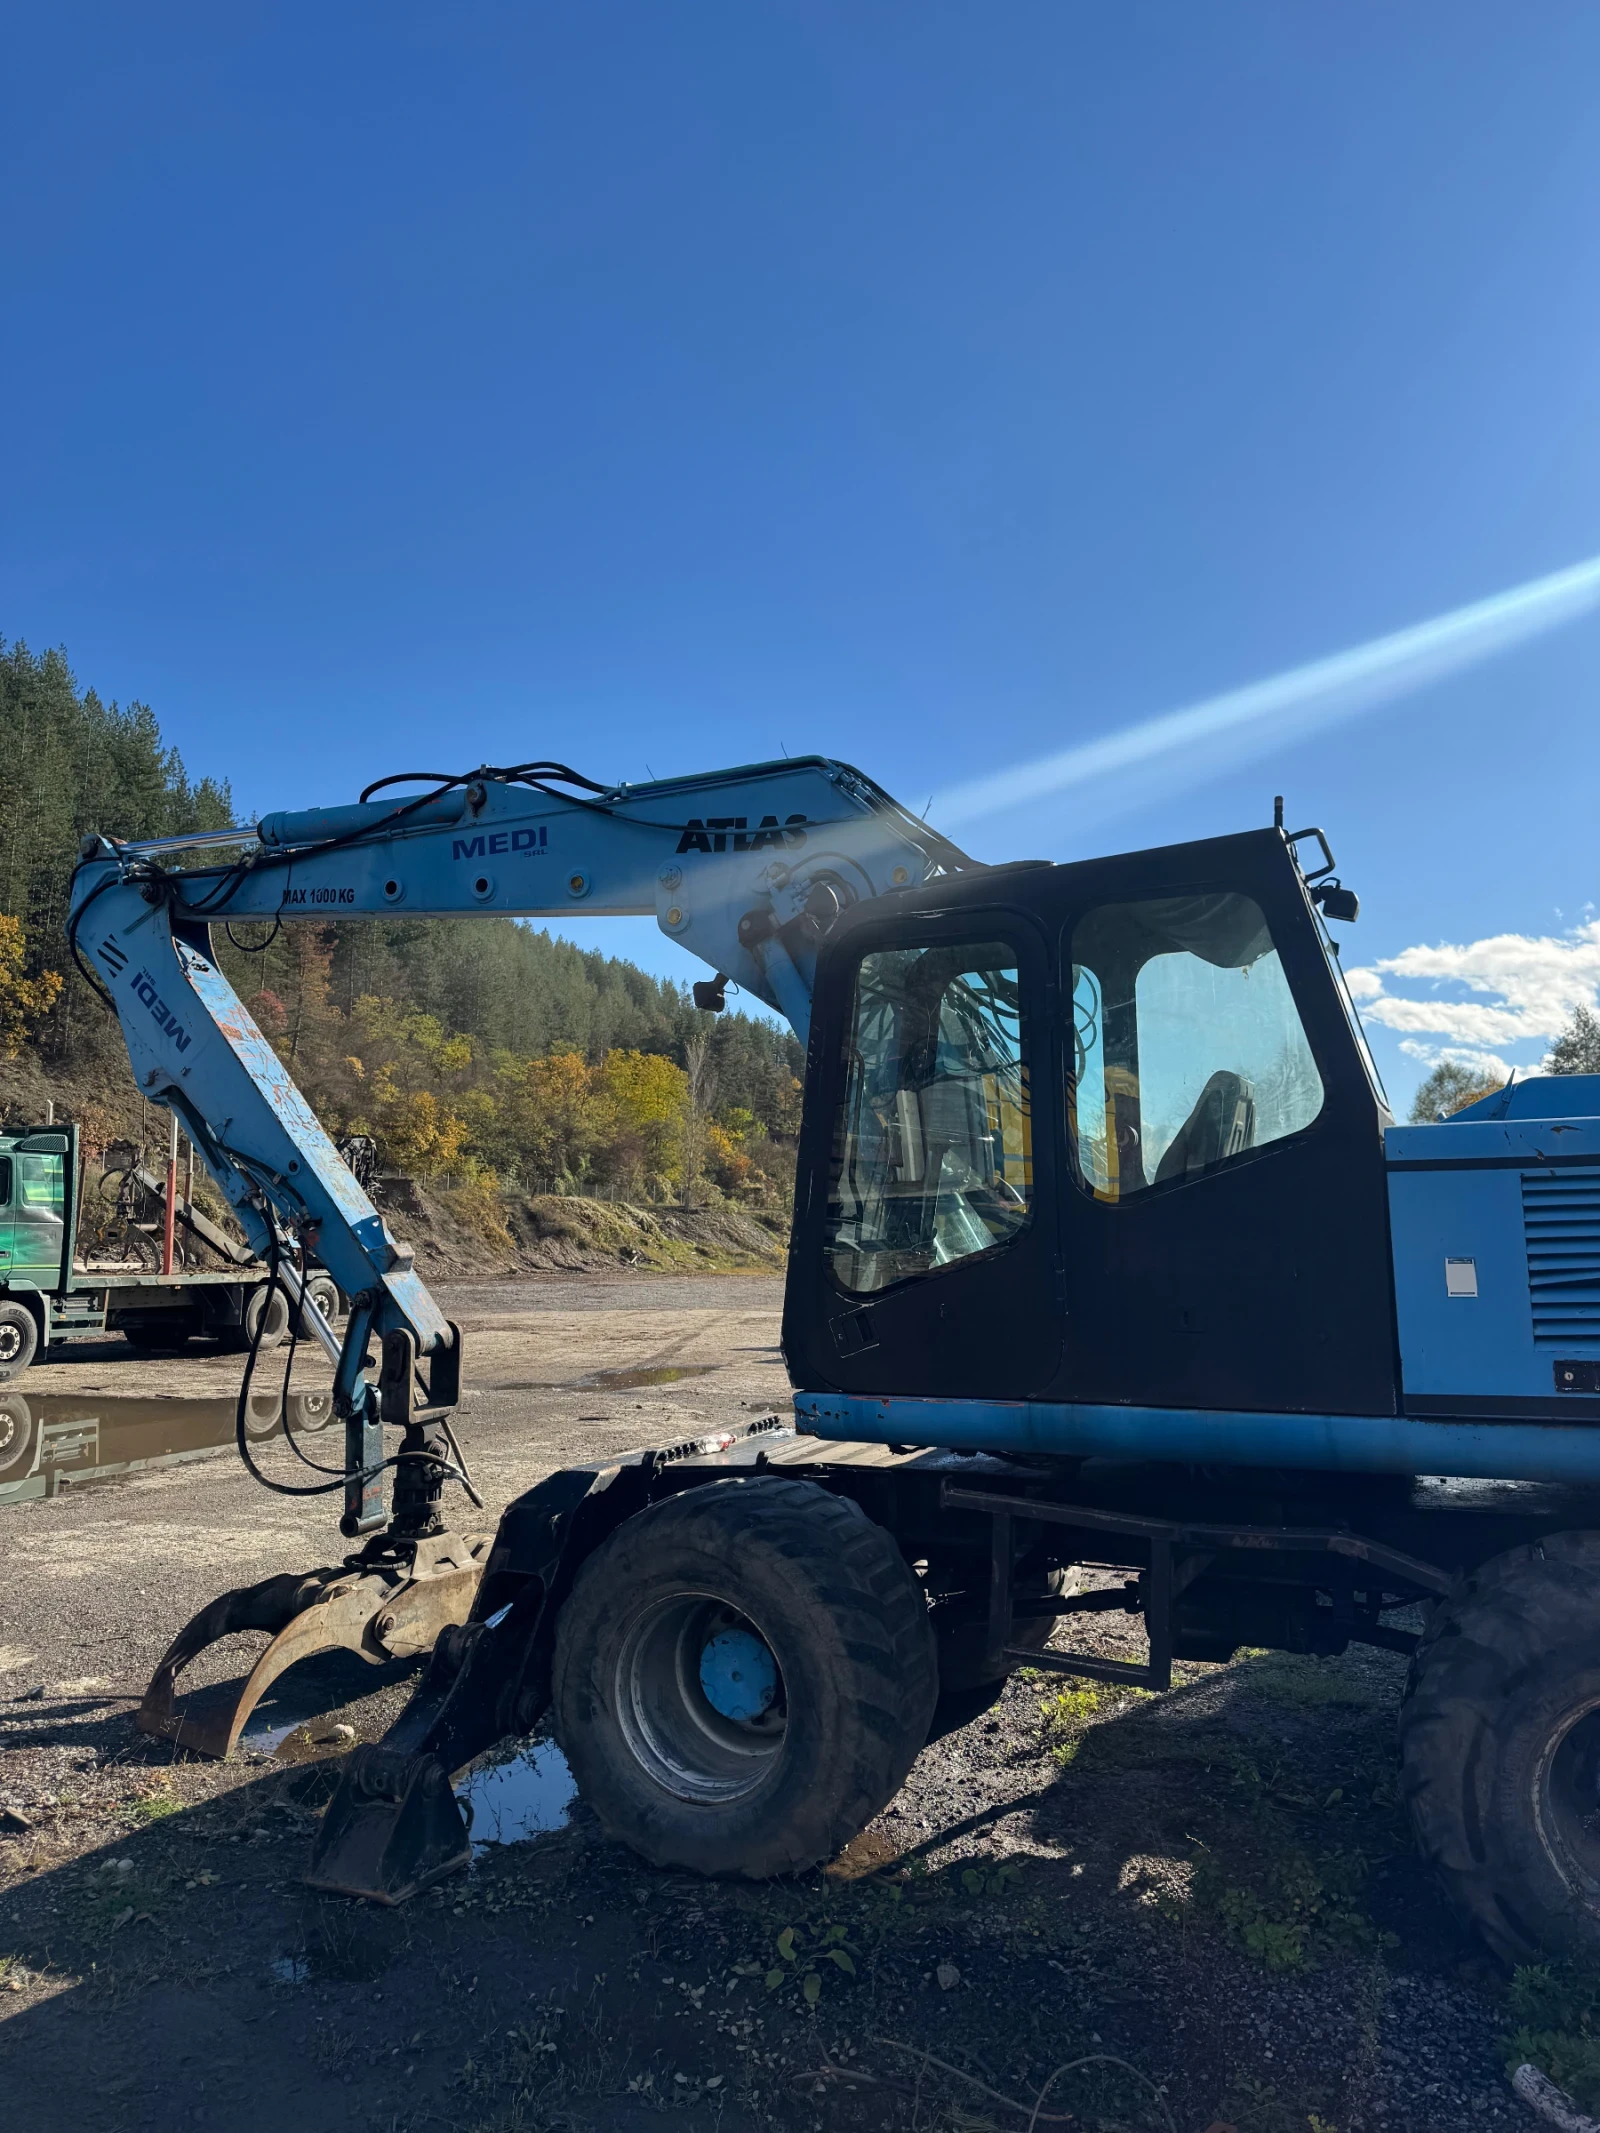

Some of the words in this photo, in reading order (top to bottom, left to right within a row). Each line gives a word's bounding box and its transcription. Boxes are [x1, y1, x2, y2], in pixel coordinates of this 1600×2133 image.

[452, 826, 548, 860] MEDI
[676, 814, 807, 853] ATLAS
[524, 849, 548, 857] SRL
[283, 889, 306, 904] MAX
[310, 888, 336, 903] 1000
[339, 888, 354, 903] KG
[142, 966, 156, 986] SRL
[130, 972, 192, 1053] MEDI
